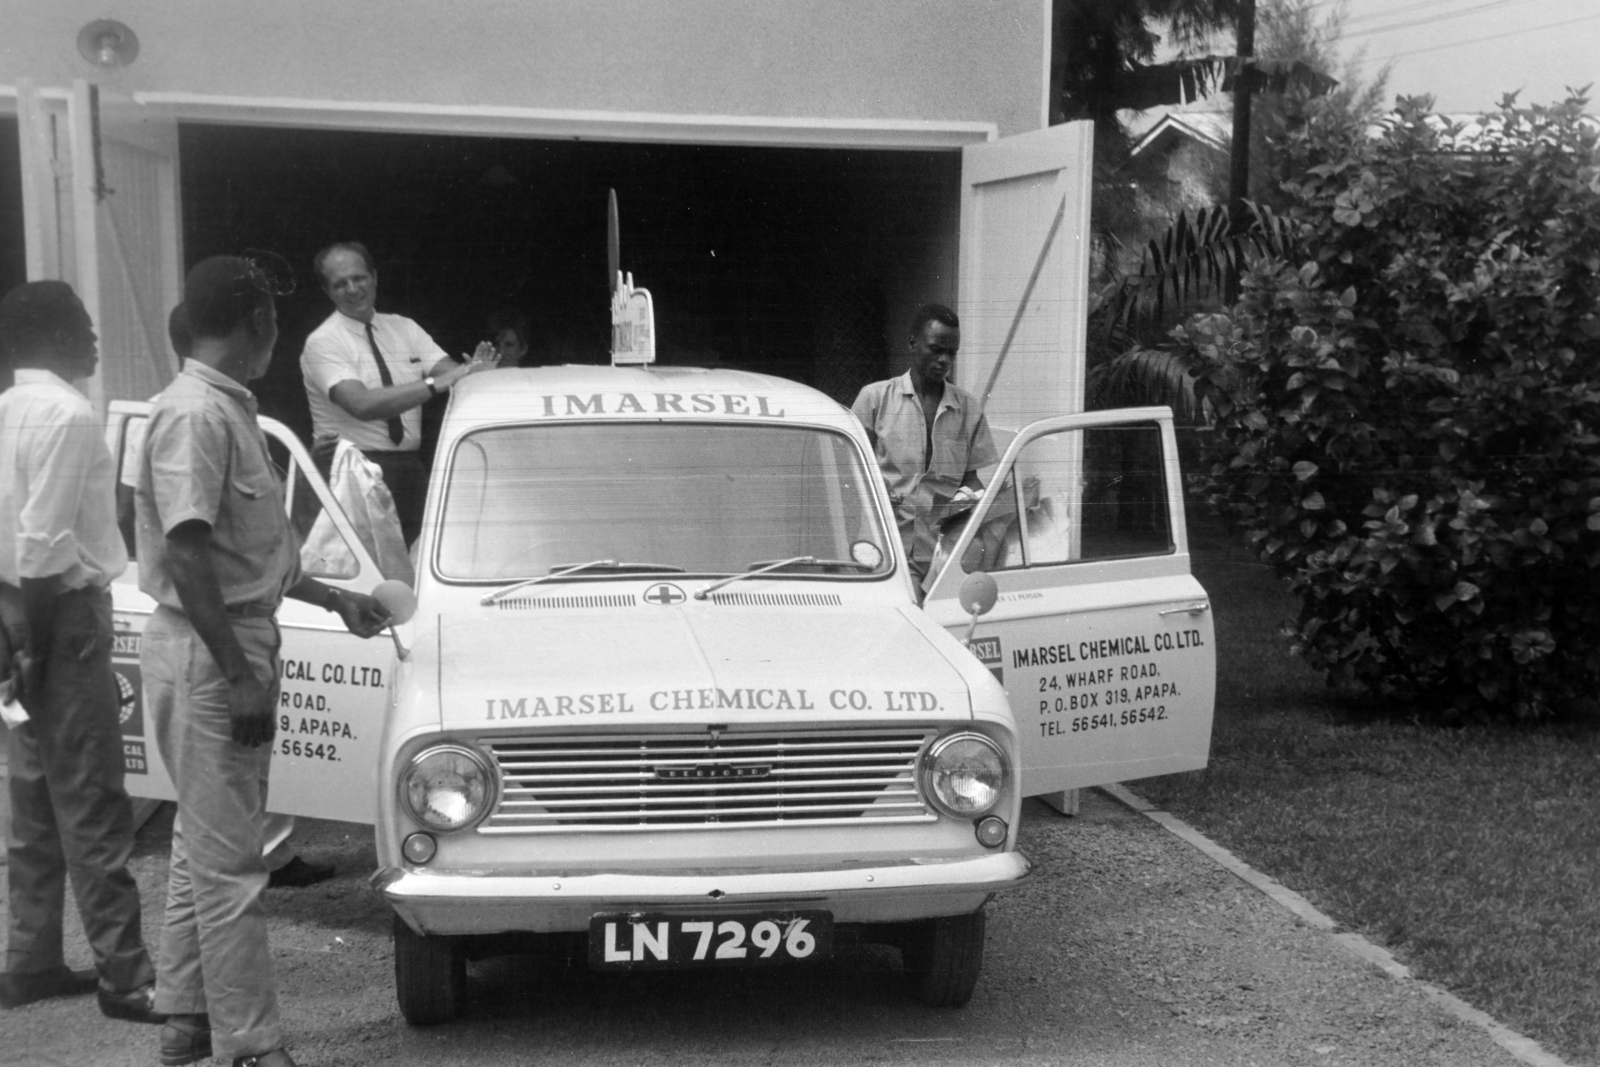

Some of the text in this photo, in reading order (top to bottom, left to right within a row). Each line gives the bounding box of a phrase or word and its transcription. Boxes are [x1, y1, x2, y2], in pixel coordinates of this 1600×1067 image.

[541, 393, 785, 418] IMARSEL
[112, 635, 141, 653] RSEL
[969, 641, 1000, 660] RSEL
[1013, 629, 1204, 669] IMARSEL CHEMICAL CO. LTD.
[280, 659, 384, 688] ICAL CO. LTD.
[1039, 663, 1161, 692] 24, WHARF ROAD,
[280, 692, 331, 712] ROAD,
[485, 687, 944, 720] IMARSEL CHEMICAL CO. LTD.
[1070, 692, 1099, 710] BOX
[1105, 688, 1131, 706] 319,
[1135, 682, 1181, 701] APAPA.
[299, 718, 357, 740] APAPA.
[1040, 705, 1168, 737] TEL. 56541, 56542.
[281, 739, 341, 761] 56542.
[604, 920, 816, 962] LN 7296
